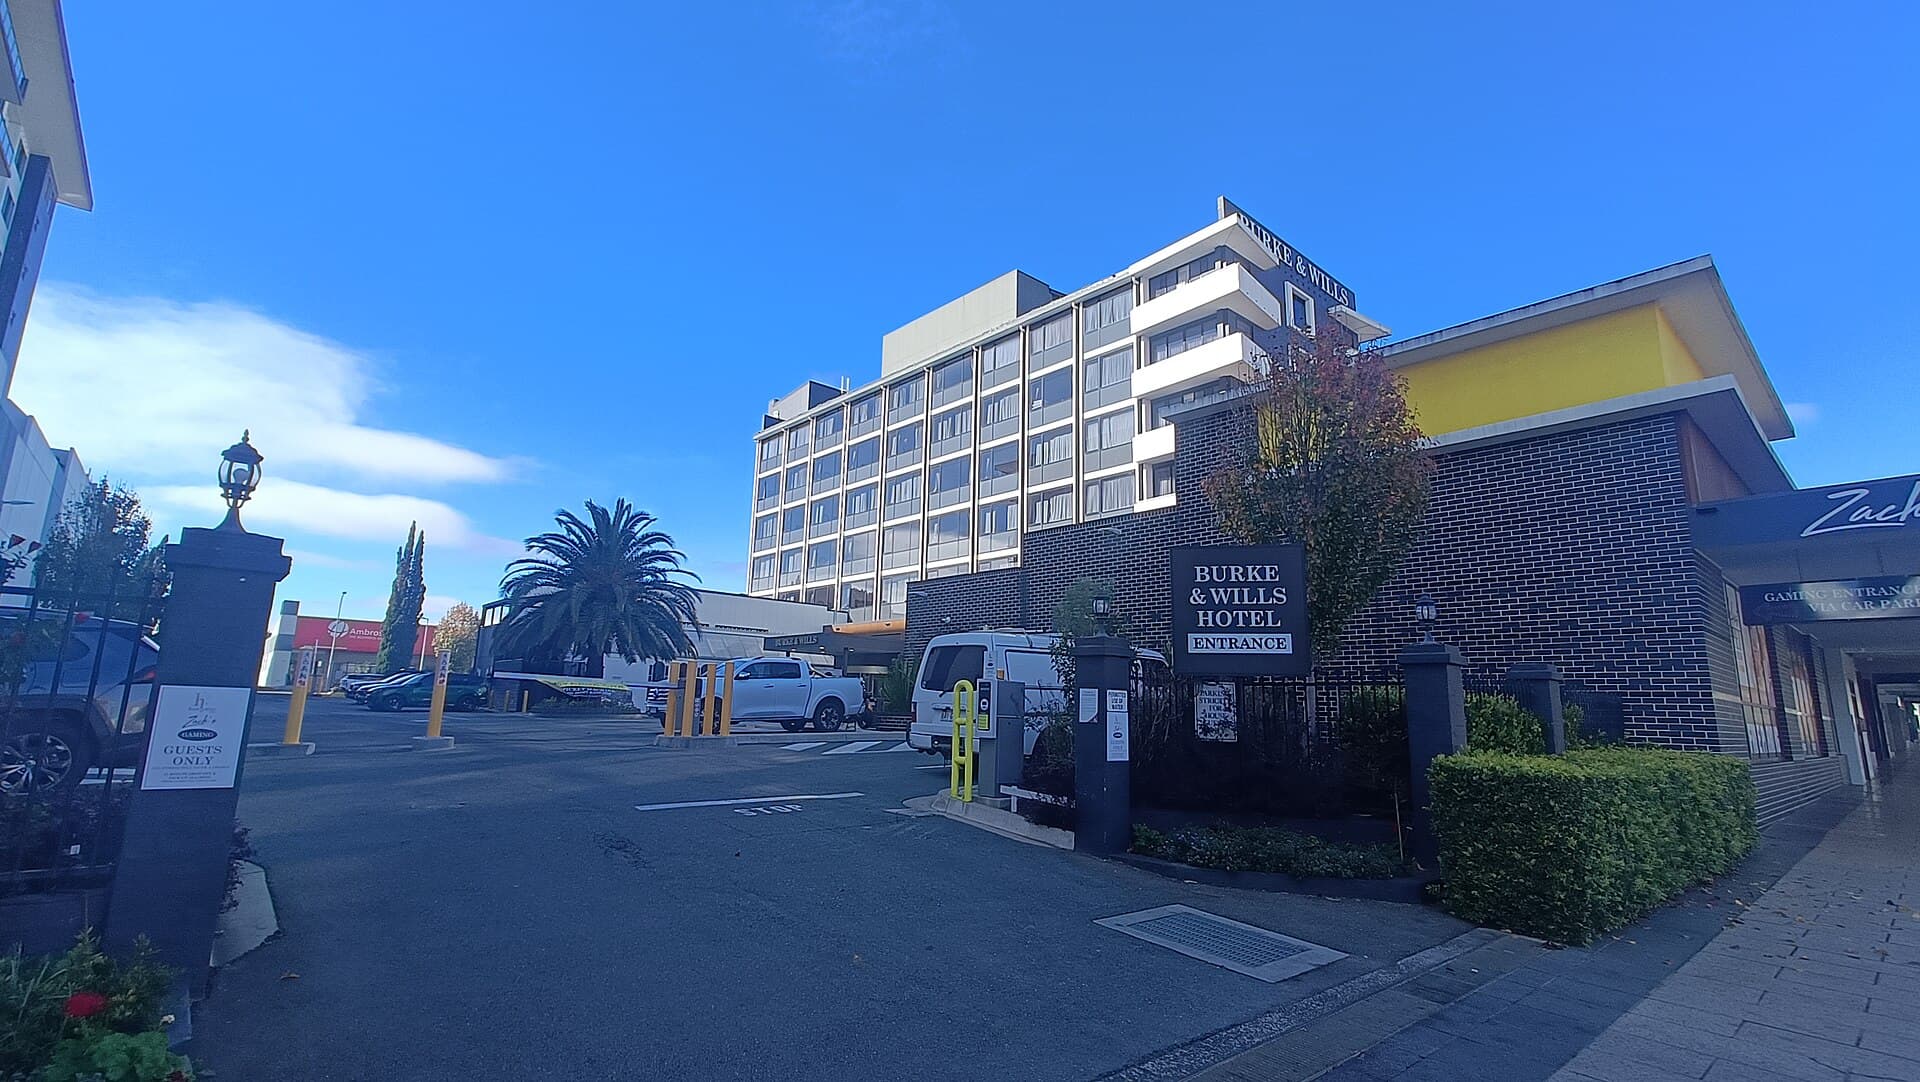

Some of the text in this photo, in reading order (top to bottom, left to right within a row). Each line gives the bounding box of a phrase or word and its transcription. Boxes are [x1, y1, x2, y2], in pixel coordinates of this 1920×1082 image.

[1295, 255, 1307, 277] &
[1307, 262, 1349, 306] WILLS
[1193, 565, 1280, 582] BURKE
[1189, 587, 1287, 605] & WILLS
[1764, 588, 1826, 602] GAMING
[1808, 602, 1840, 613] VIA
[1841, 599, 1877, 611] CAR
[1197, 610, 1281, 627] HOTEL
[1193, 638, 1287, 649] ENTRANCE
[163, 745, 223, 755] GUESTS
[172, 756, 214, 765] ONLY
[733, 804, 803, 816] STOP
